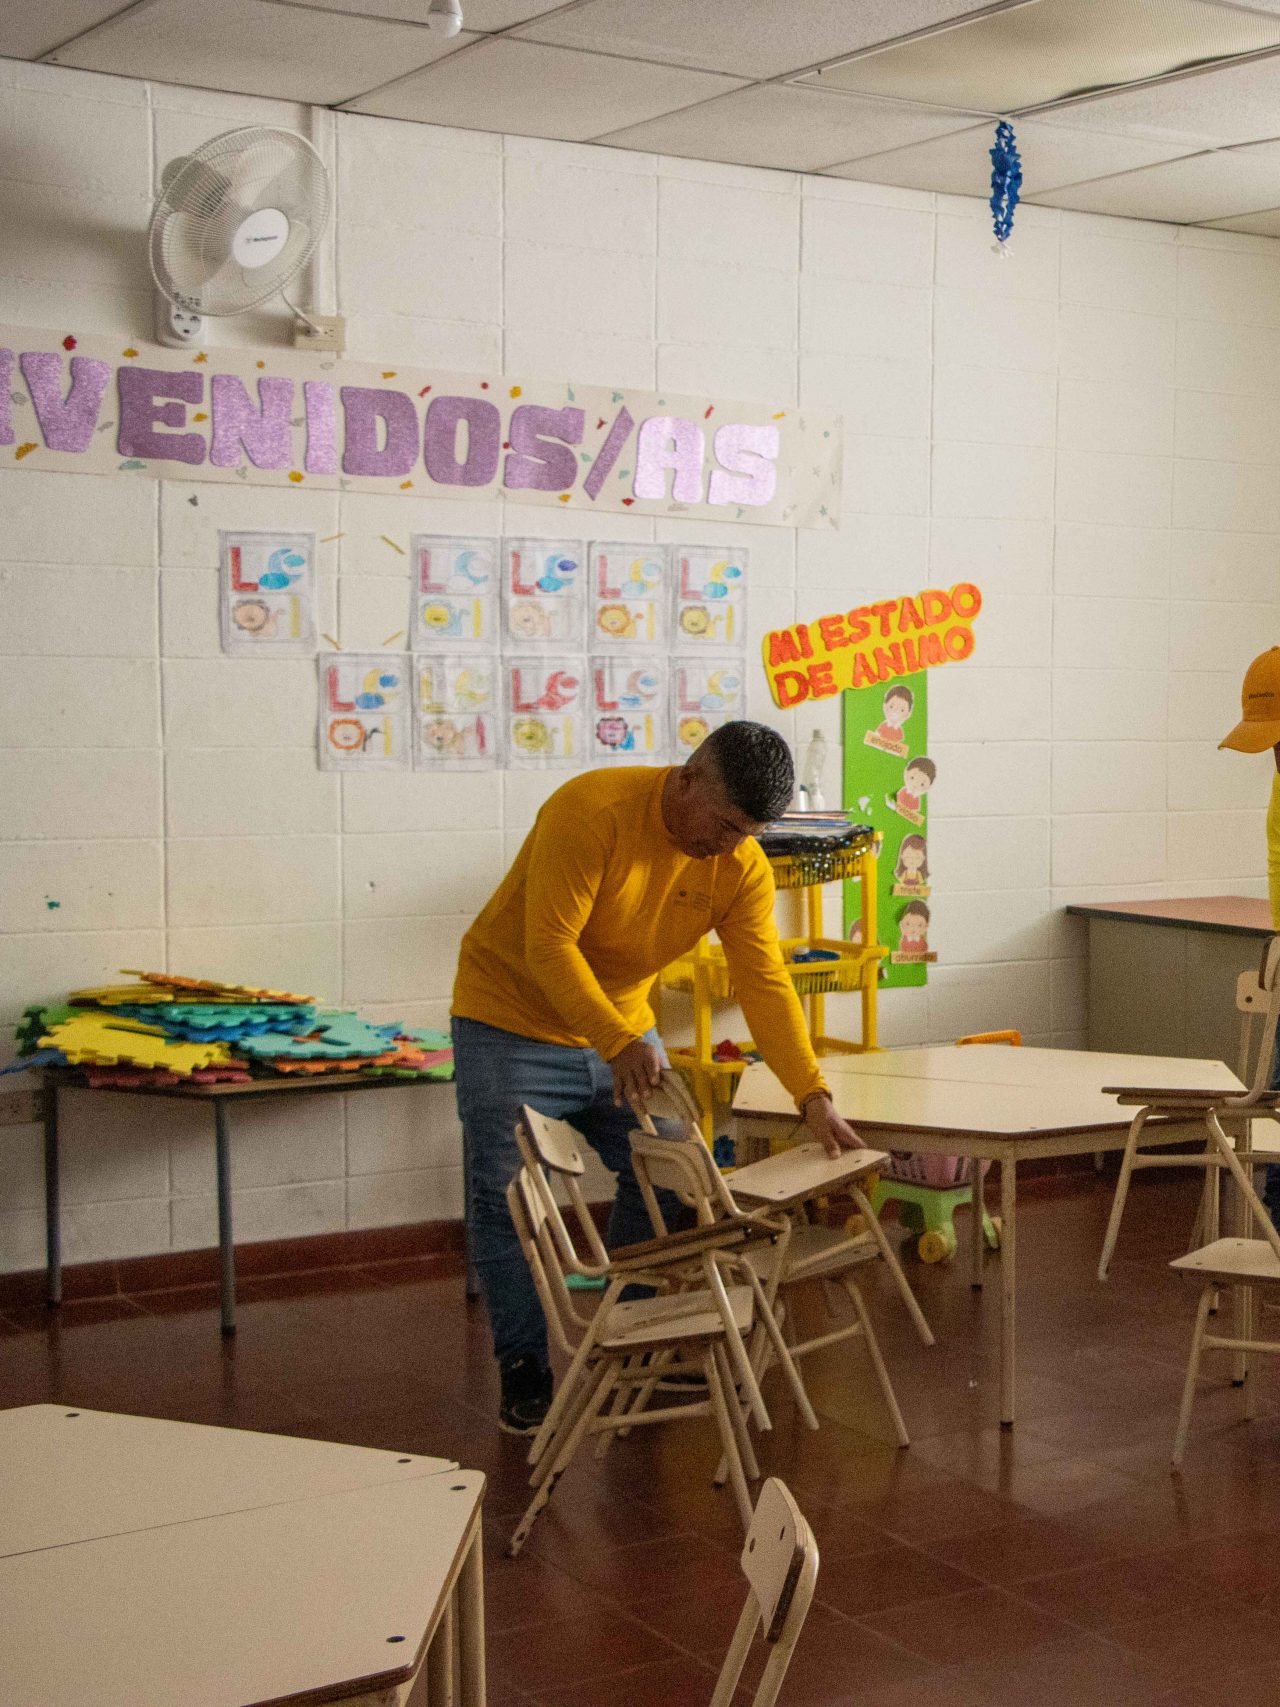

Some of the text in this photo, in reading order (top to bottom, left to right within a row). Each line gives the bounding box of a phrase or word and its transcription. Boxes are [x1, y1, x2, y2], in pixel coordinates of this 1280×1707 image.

[0, 348, 780, 506] VENIDOS/AS
[769, 583, 982, 667] MI ESTADO
[774, 625, 975, 708] DE ANIMO
